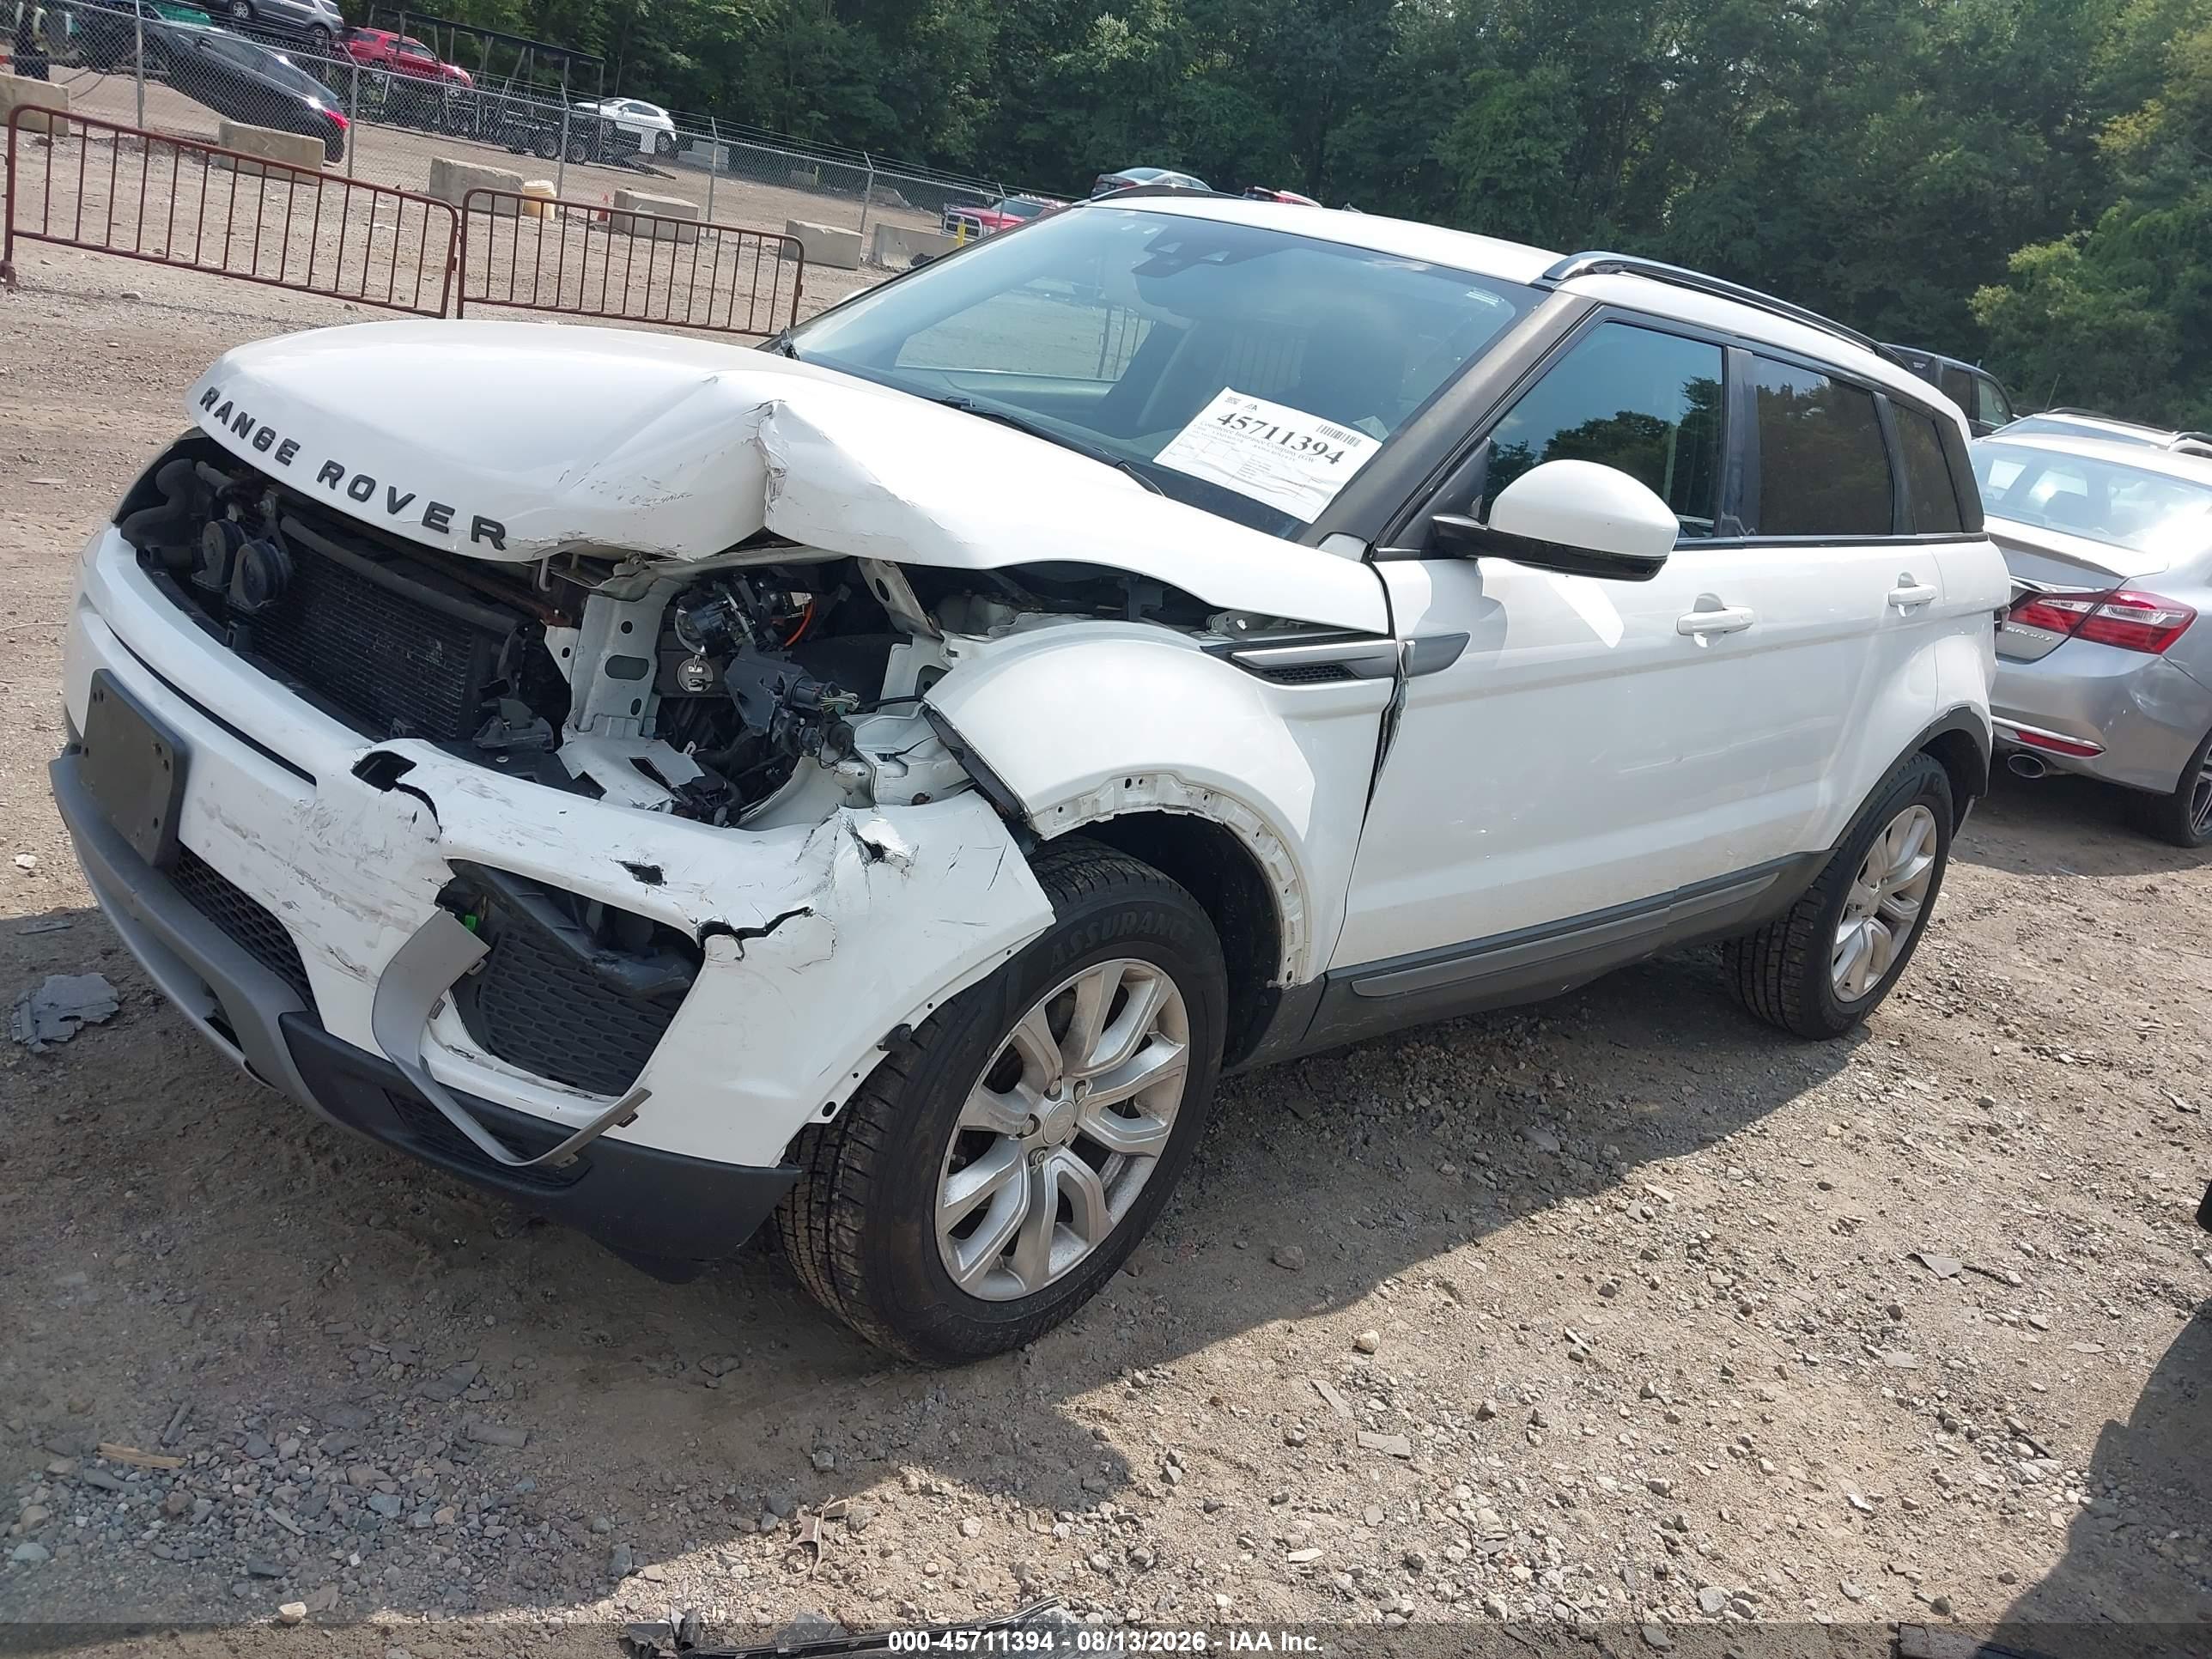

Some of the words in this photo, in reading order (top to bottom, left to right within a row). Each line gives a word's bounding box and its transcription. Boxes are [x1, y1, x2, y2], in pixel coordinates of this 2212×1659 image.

[199, 386, 301, 466] RANGE
[316, 459, 507, 550] ROVER
[1216, 412, 1346, 465] 45711394
